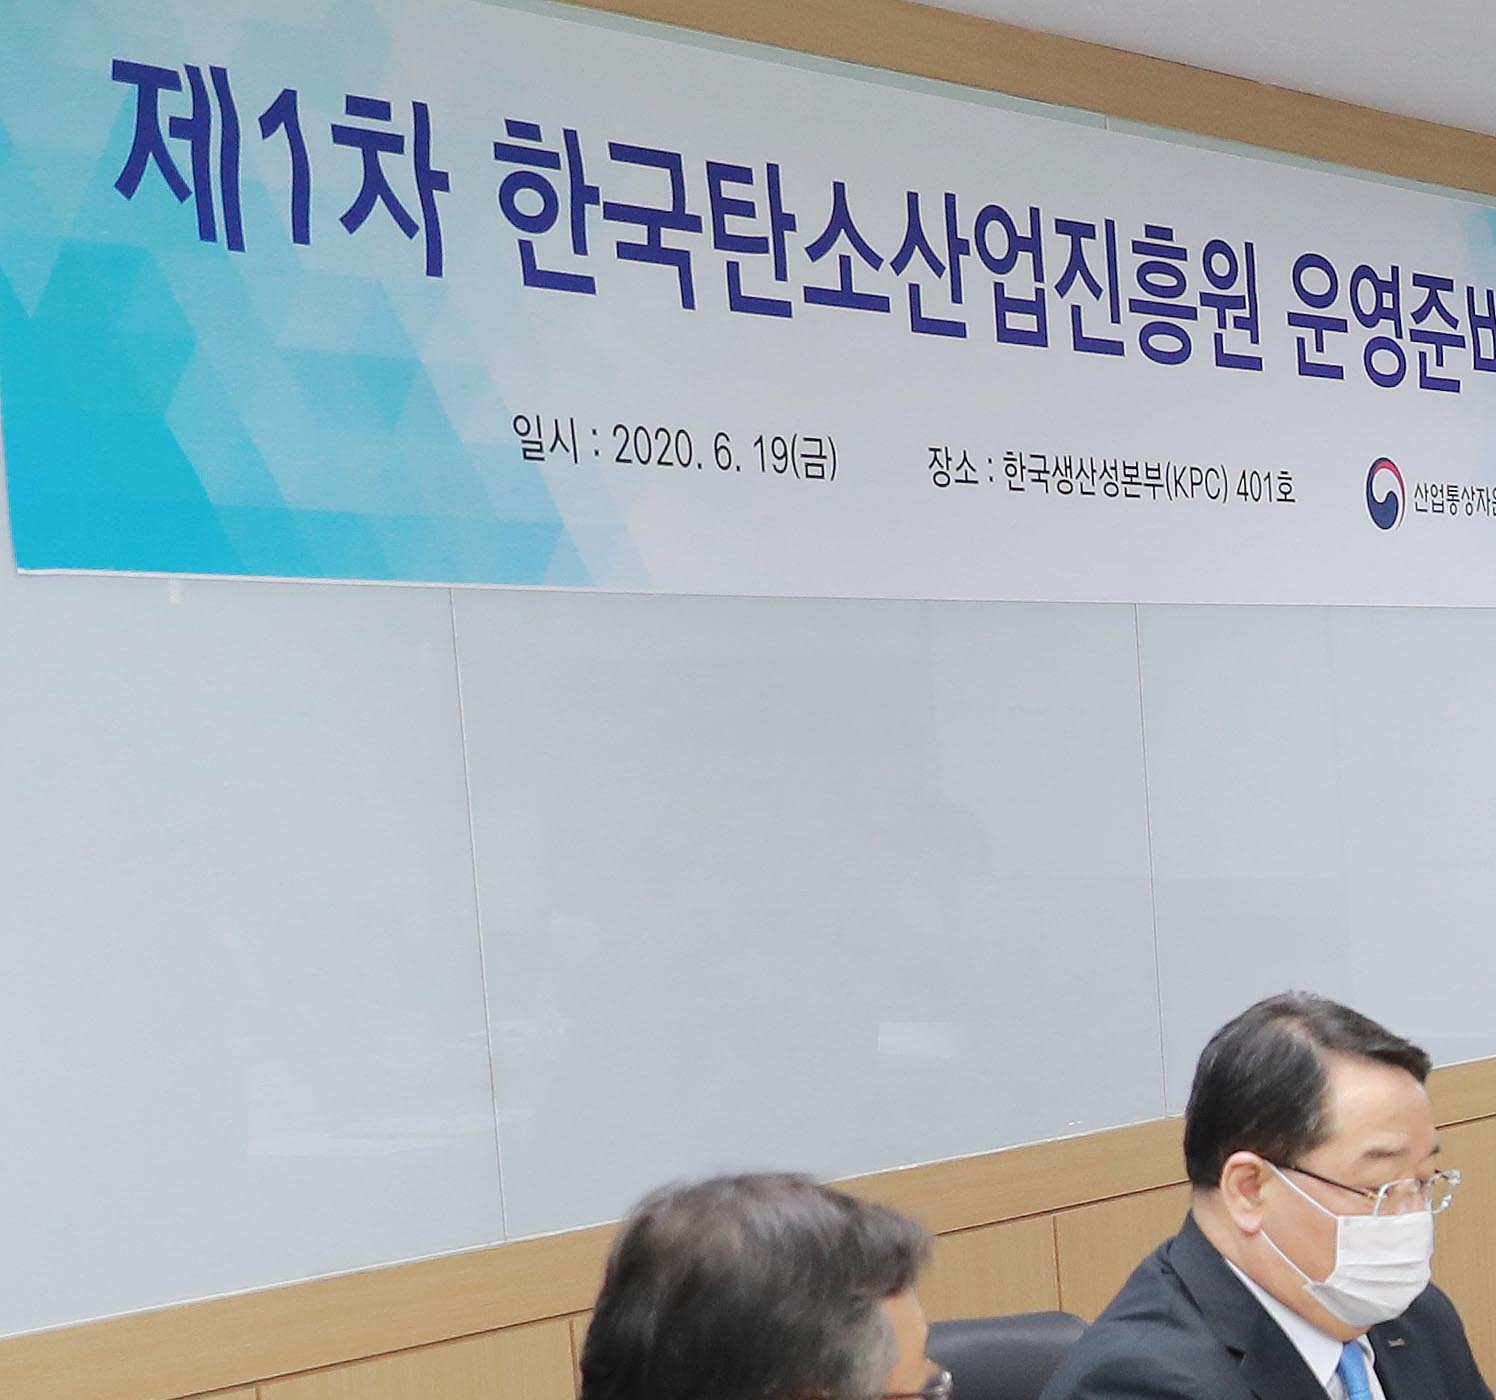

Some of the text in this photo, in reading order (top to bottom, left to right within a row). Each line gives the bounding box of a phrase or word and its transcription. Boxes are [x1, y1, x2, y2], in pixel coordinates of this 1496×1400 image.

[111, 58, 450, 279] 제1차
[493, 117, 1263, 372] 한국탄소산업진흥원
[511, 413, 579, 466] 일시
[612, 424, 704, 471] 2020.
[713, 432, 742, 473] 6.
[752, 434, 838, 483] 19(금)
[926, 445, 980, 490] 장소
[1002, 450, 1230, 506] 한국생산성본부(KPC)
[1236, 469, 1297, 507] 401호
